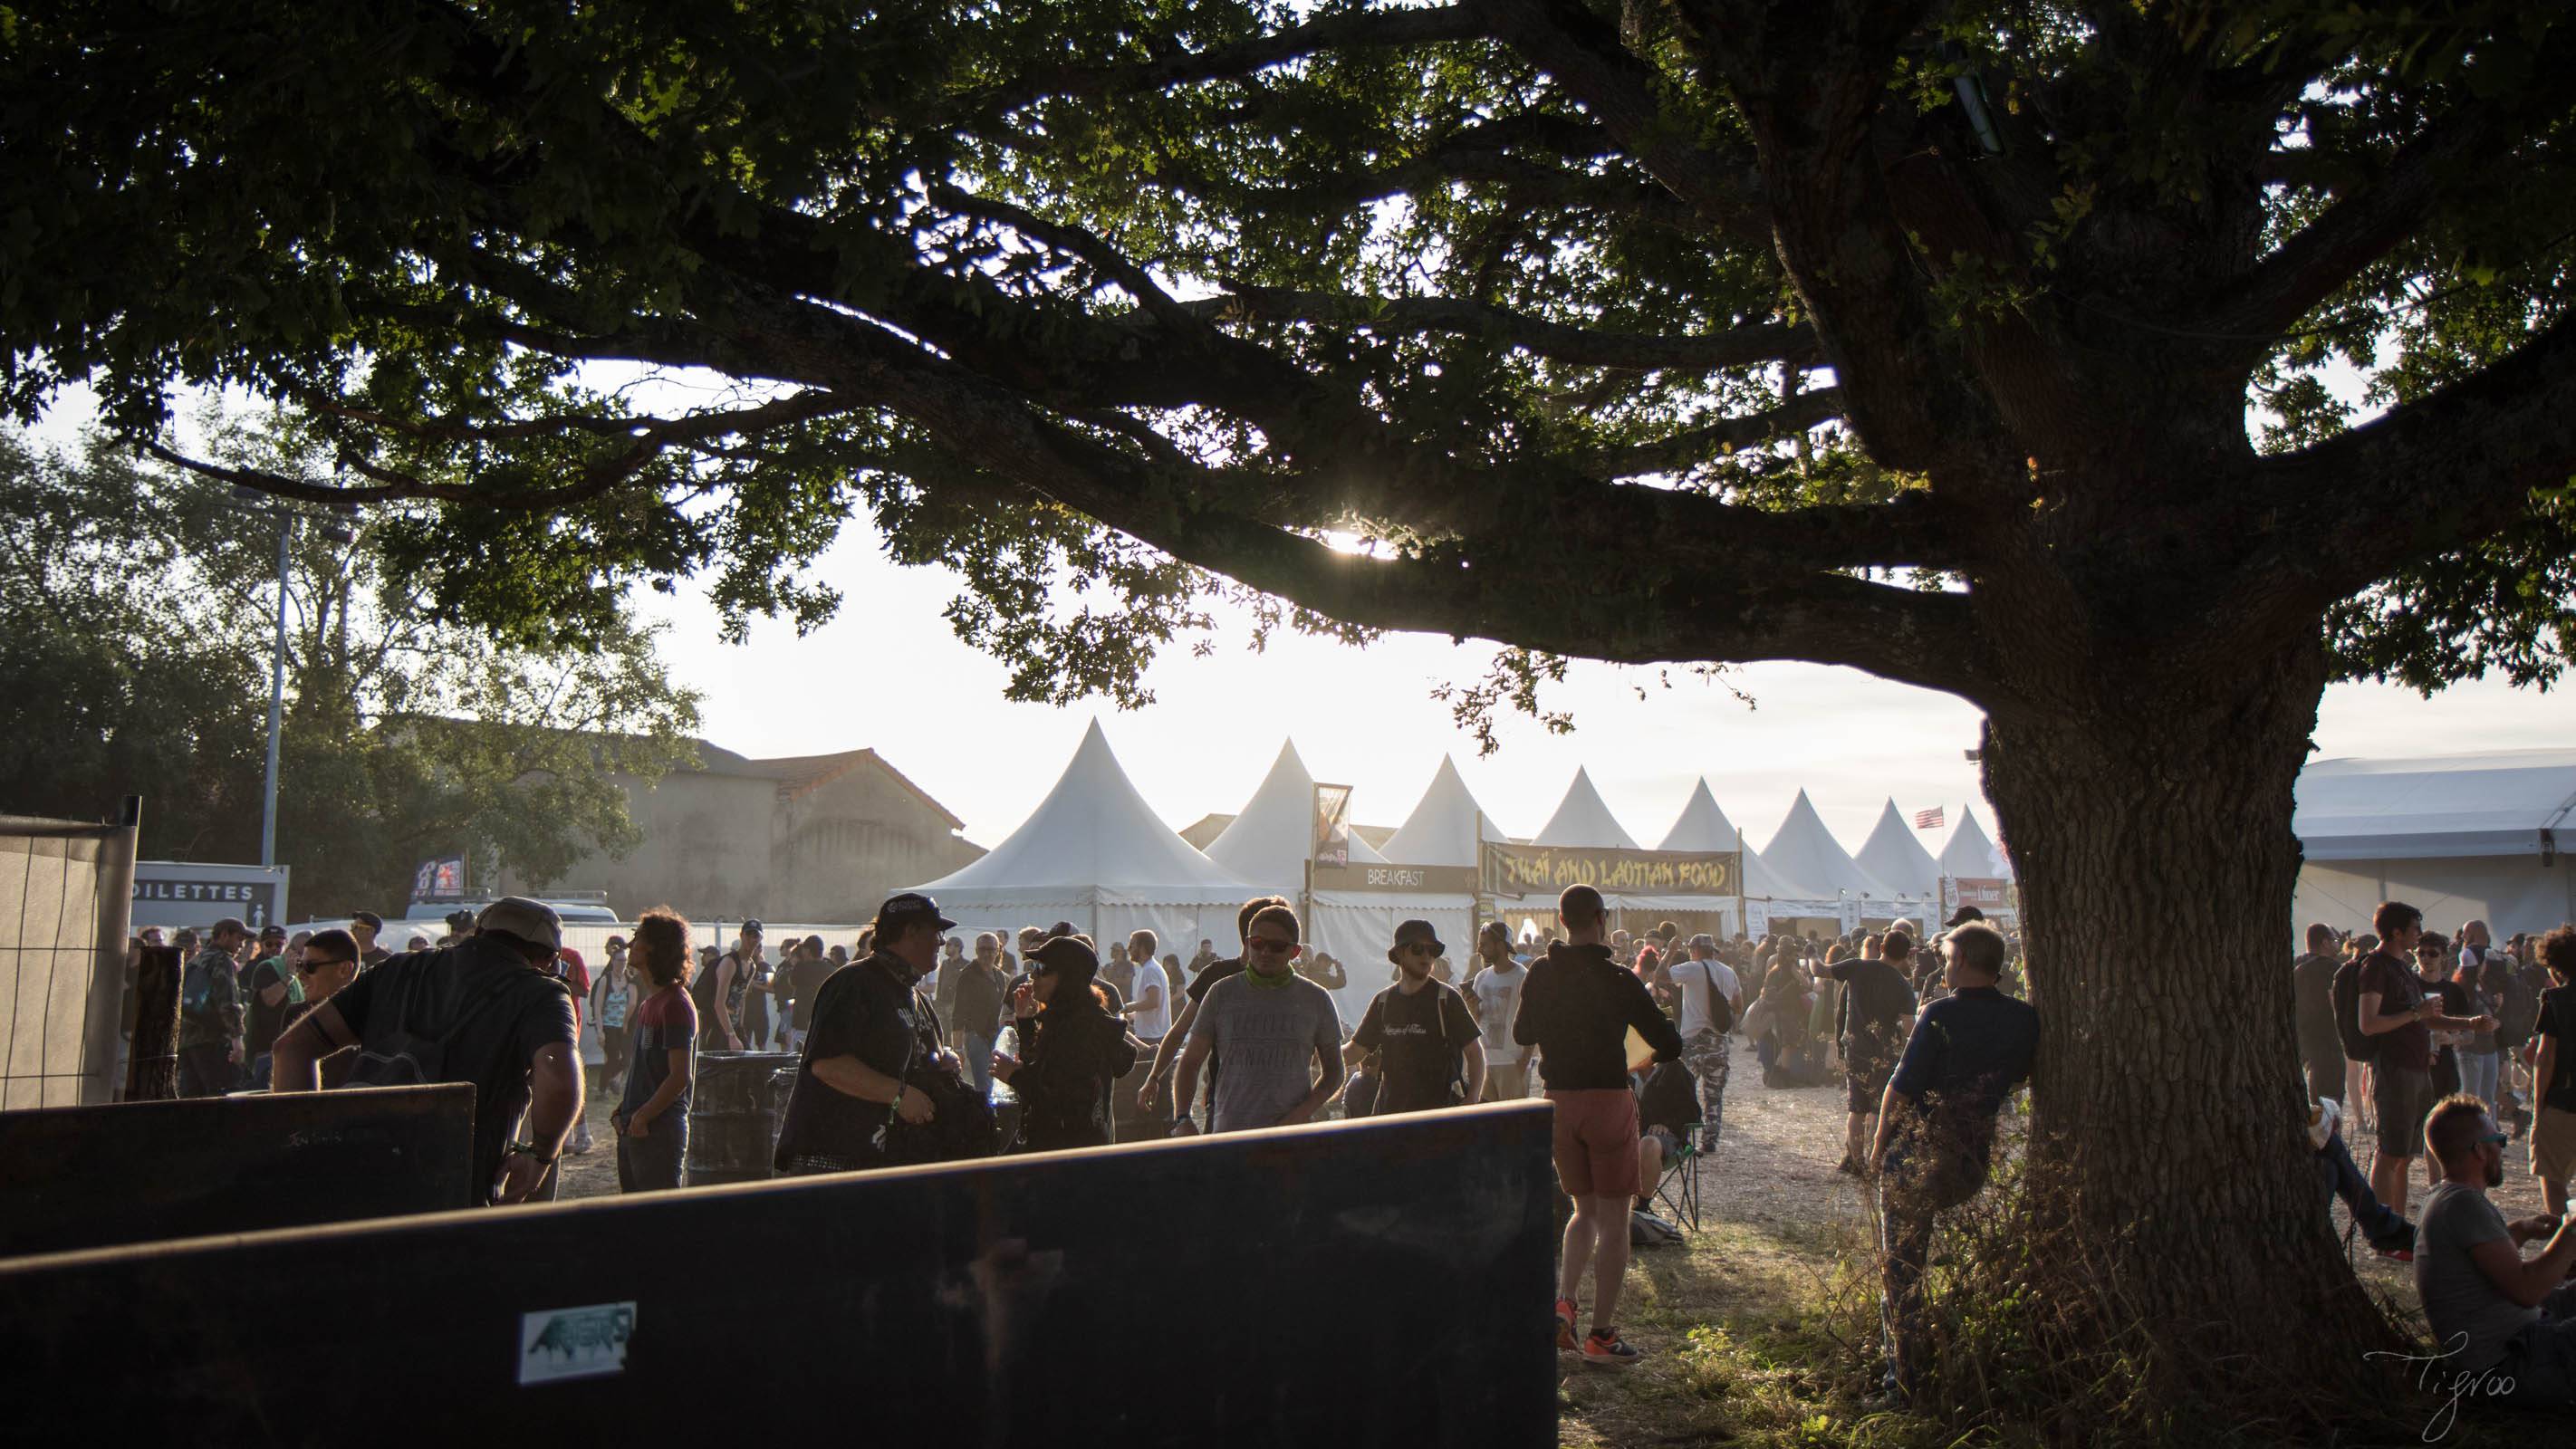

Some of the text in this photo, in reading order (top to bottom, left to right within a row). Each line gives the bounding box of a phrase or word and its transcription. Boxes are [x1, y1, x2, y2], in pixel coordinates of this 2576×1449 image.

[1368, 869, 1425, 886] BREAKFAST
[1554, 856, 1595, 886] AND
[1600, 859, 1674, 887] LAOTIAN
[1678, 861, 1725, 886] FOOD
